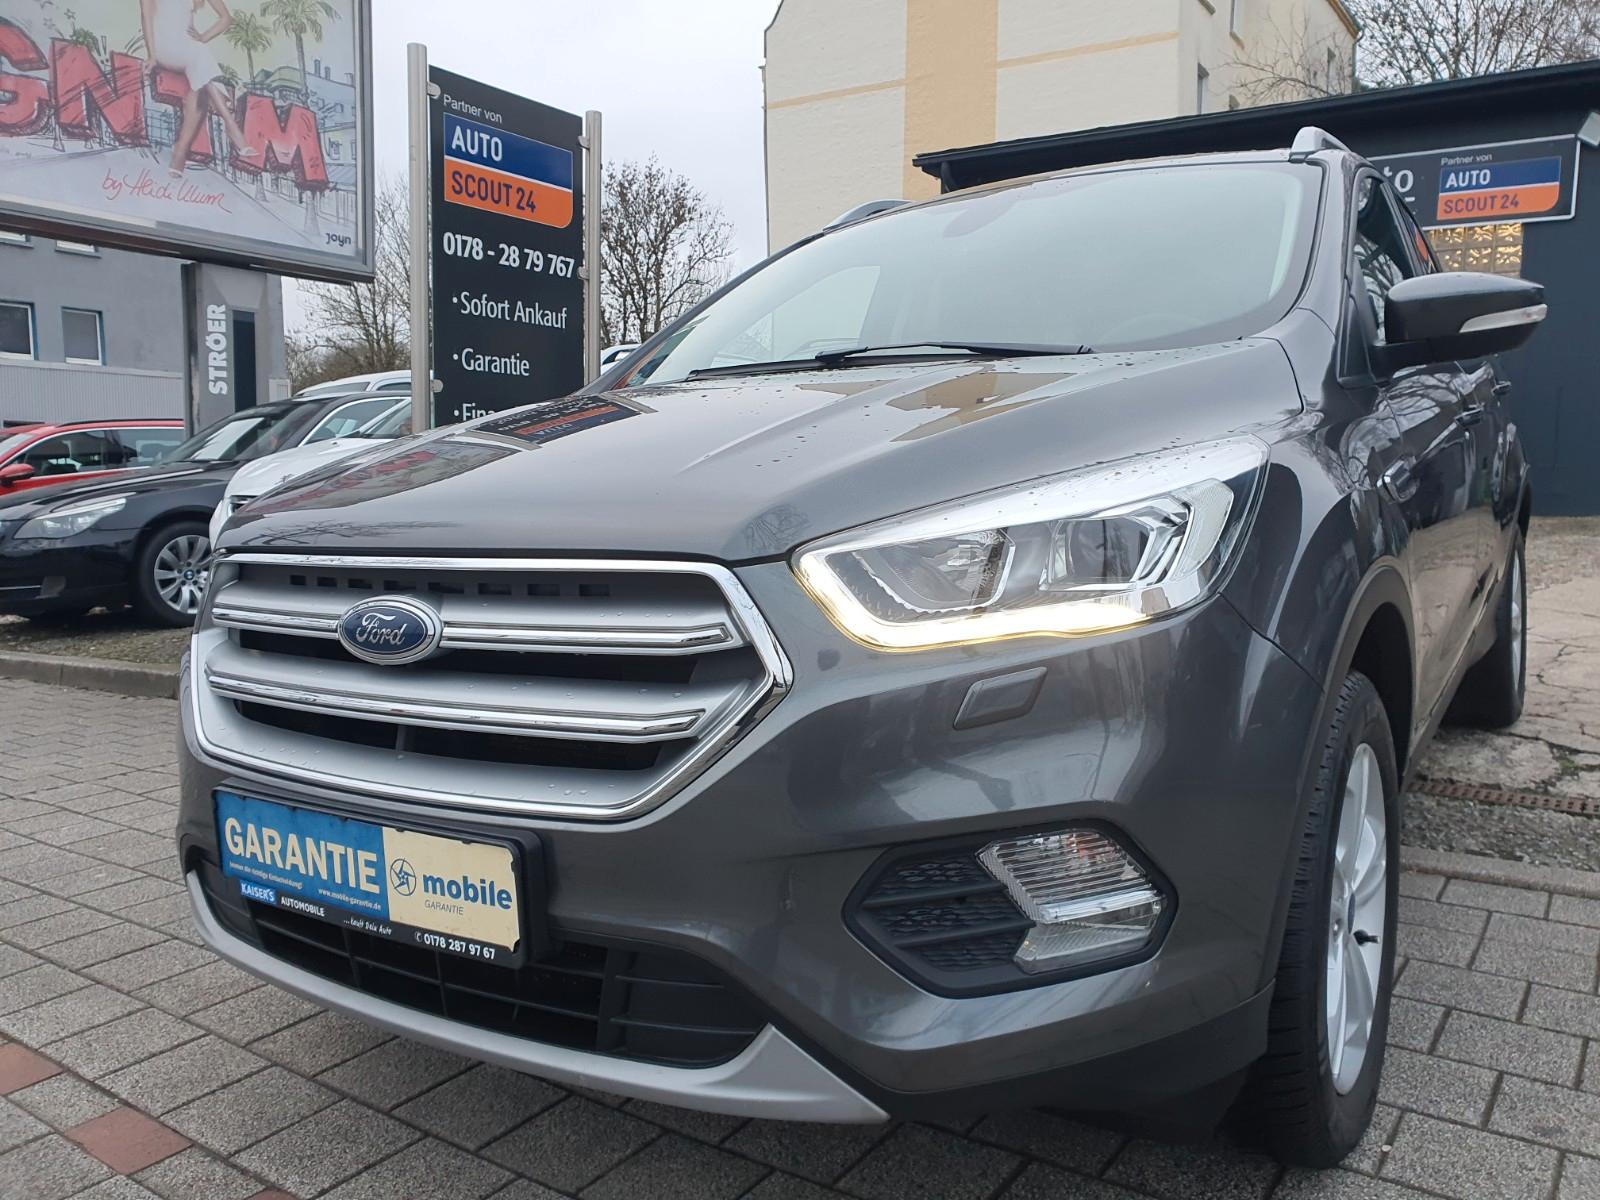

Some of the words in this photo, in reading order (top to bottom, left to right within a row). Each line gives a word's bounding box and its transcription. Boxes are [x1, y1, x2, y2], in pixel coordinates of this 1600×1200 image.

[443, 94, 482, 117] Partner
[484, 109, 502, 123] von
[452, 125, 503, 162] AUTO
[1441, 155, 1473, 167] Partner
[1475, 153, 1492, 163] von
[102, 168, 122, 200] by
[1445, 169, 1491, 188] AUTO
[443, 232, 484, 261] 0178
[499, 244, 520, 268] 28
[523, 248, 544, 272] 79
[547, 253, 575, 279] 767
[460, 291, 510, 321] Sofort
[514, 301, 567, 329] Ankauf
[205, 304, 228, 395] STRÖER
[461, 348, 530, 377] Garantie
[356, 612, 408, 645] Ford
[224, 817, 380, 894] GARANTIE
[280, 896, 325, 917] AUTOMOBILE
[423, 873, 513, 910] mobile
[424, 899, 464, 916] GARANTIE
[423, 933, 446, 949] 0178
[449, 938, 466, 953] 287
